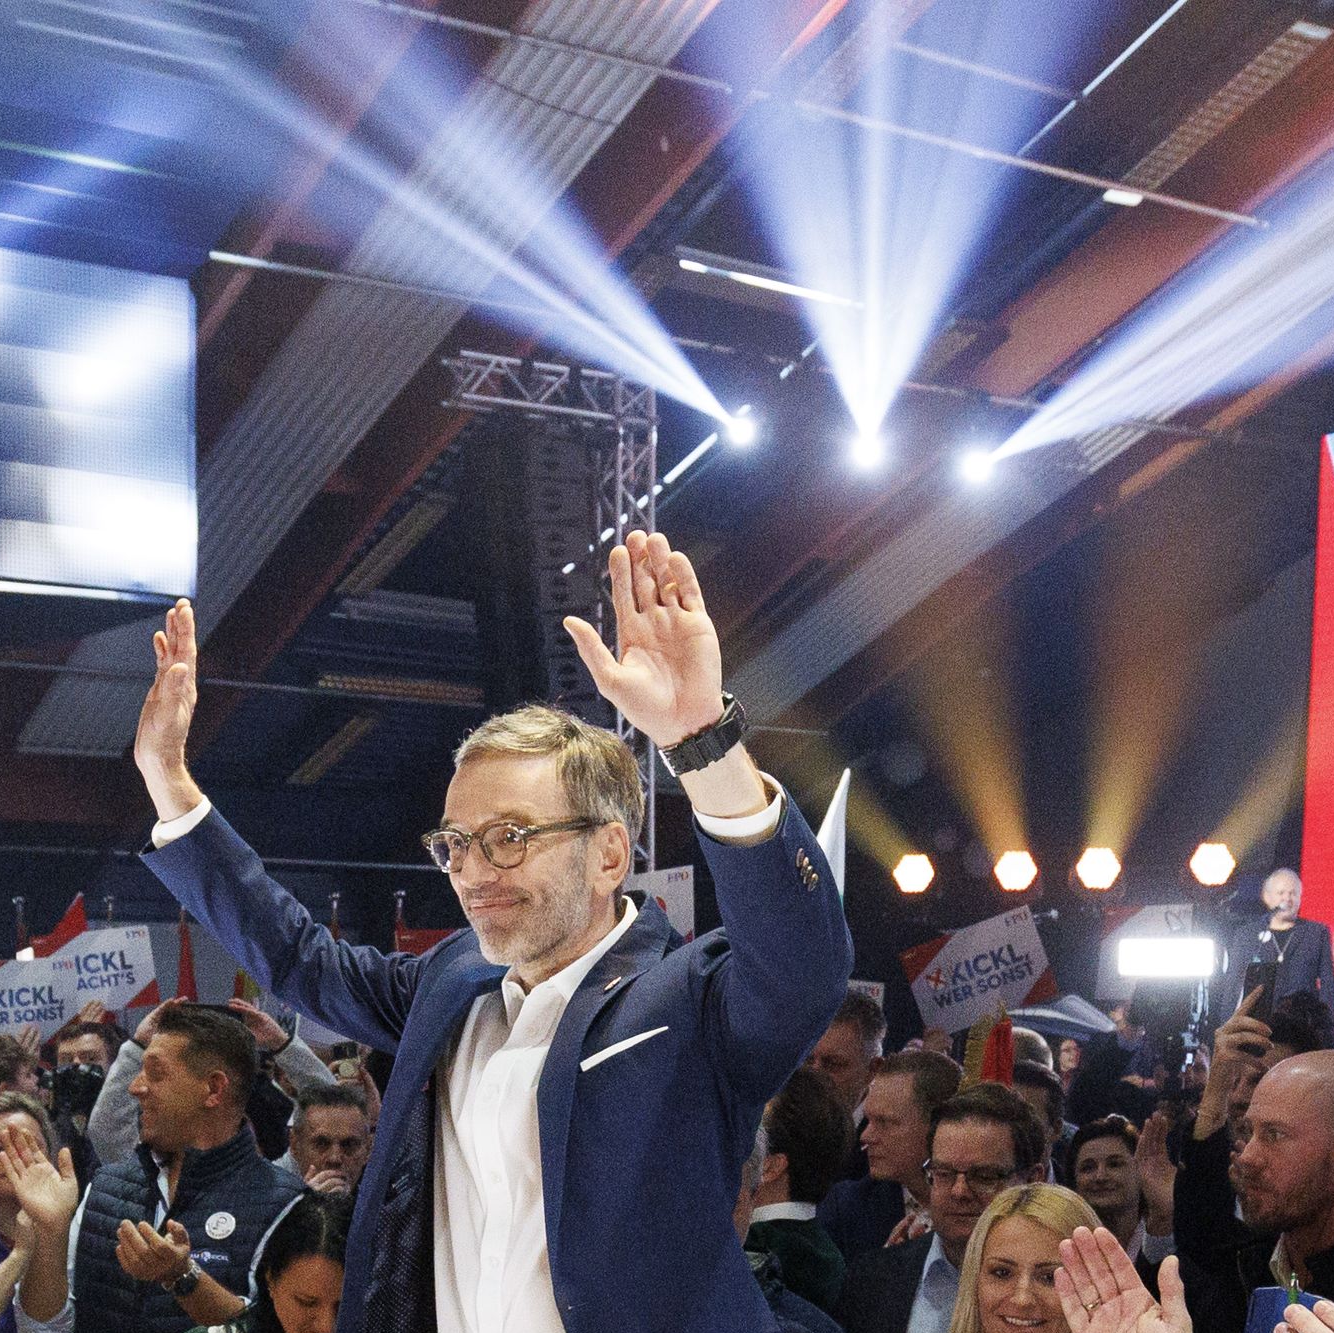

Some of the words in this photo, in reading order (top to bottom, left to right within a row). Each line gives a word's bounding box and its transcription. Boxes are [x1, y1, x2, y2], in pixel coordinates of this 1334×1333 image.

[75, 950, 133, 975] ICKL
[76, 971, 135, 991] ACHT'S
[933, 984, 973, 1009] WER
[977, 963, 1034, 994] SONST
[14, 1005, 65, 1023] SONST
